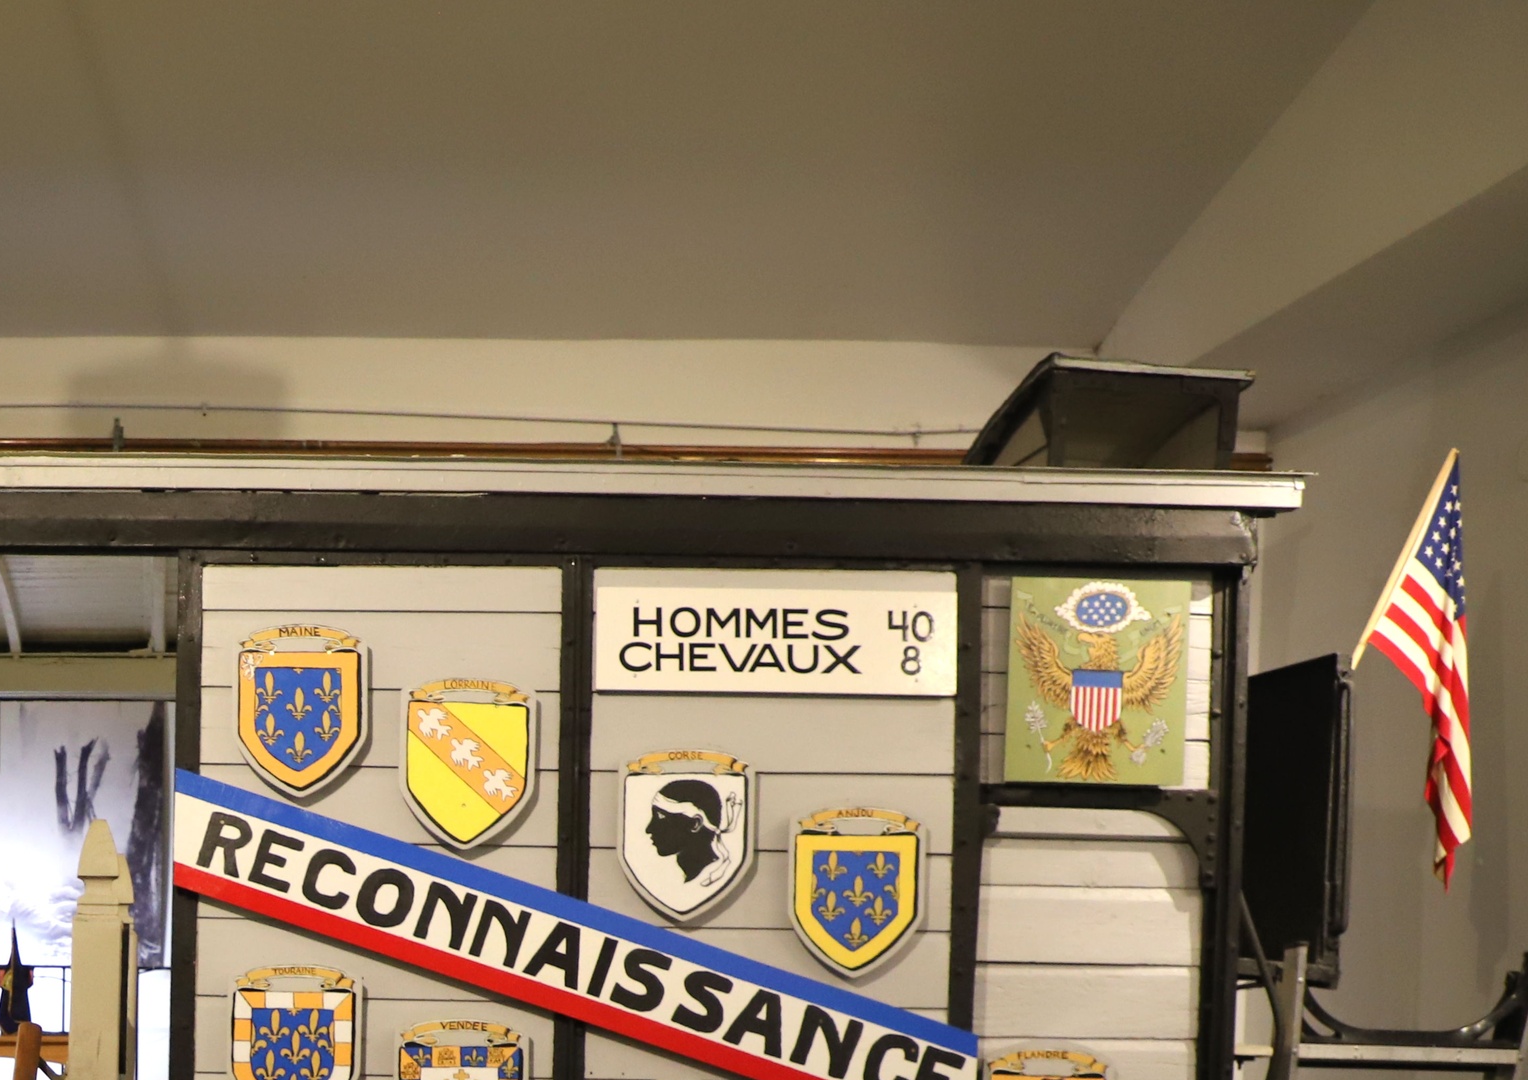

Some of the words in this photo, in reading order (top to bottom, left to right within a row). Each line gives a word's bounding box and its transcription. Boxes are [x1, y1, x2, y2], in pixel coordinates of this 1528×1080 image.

[633, 607, 850, 641] HOMMES
[887, 609, 935, 642] 40
[278, 626, 322, 638] MAINE
[618, 641, 863, 675] CHEVAUX
[900, 645, 922, 676] 8
[443, 679, 496, 691] LORRAINE
[668, 751, 703, 761] CORSE
[836, 808, 874, 818] ANJOU
[272, 967, 317, 976] TOURAINE
[440, 1020, 489, 1032] VENDEE
[1017, 1051, 1069, 1060] FLANDRE
